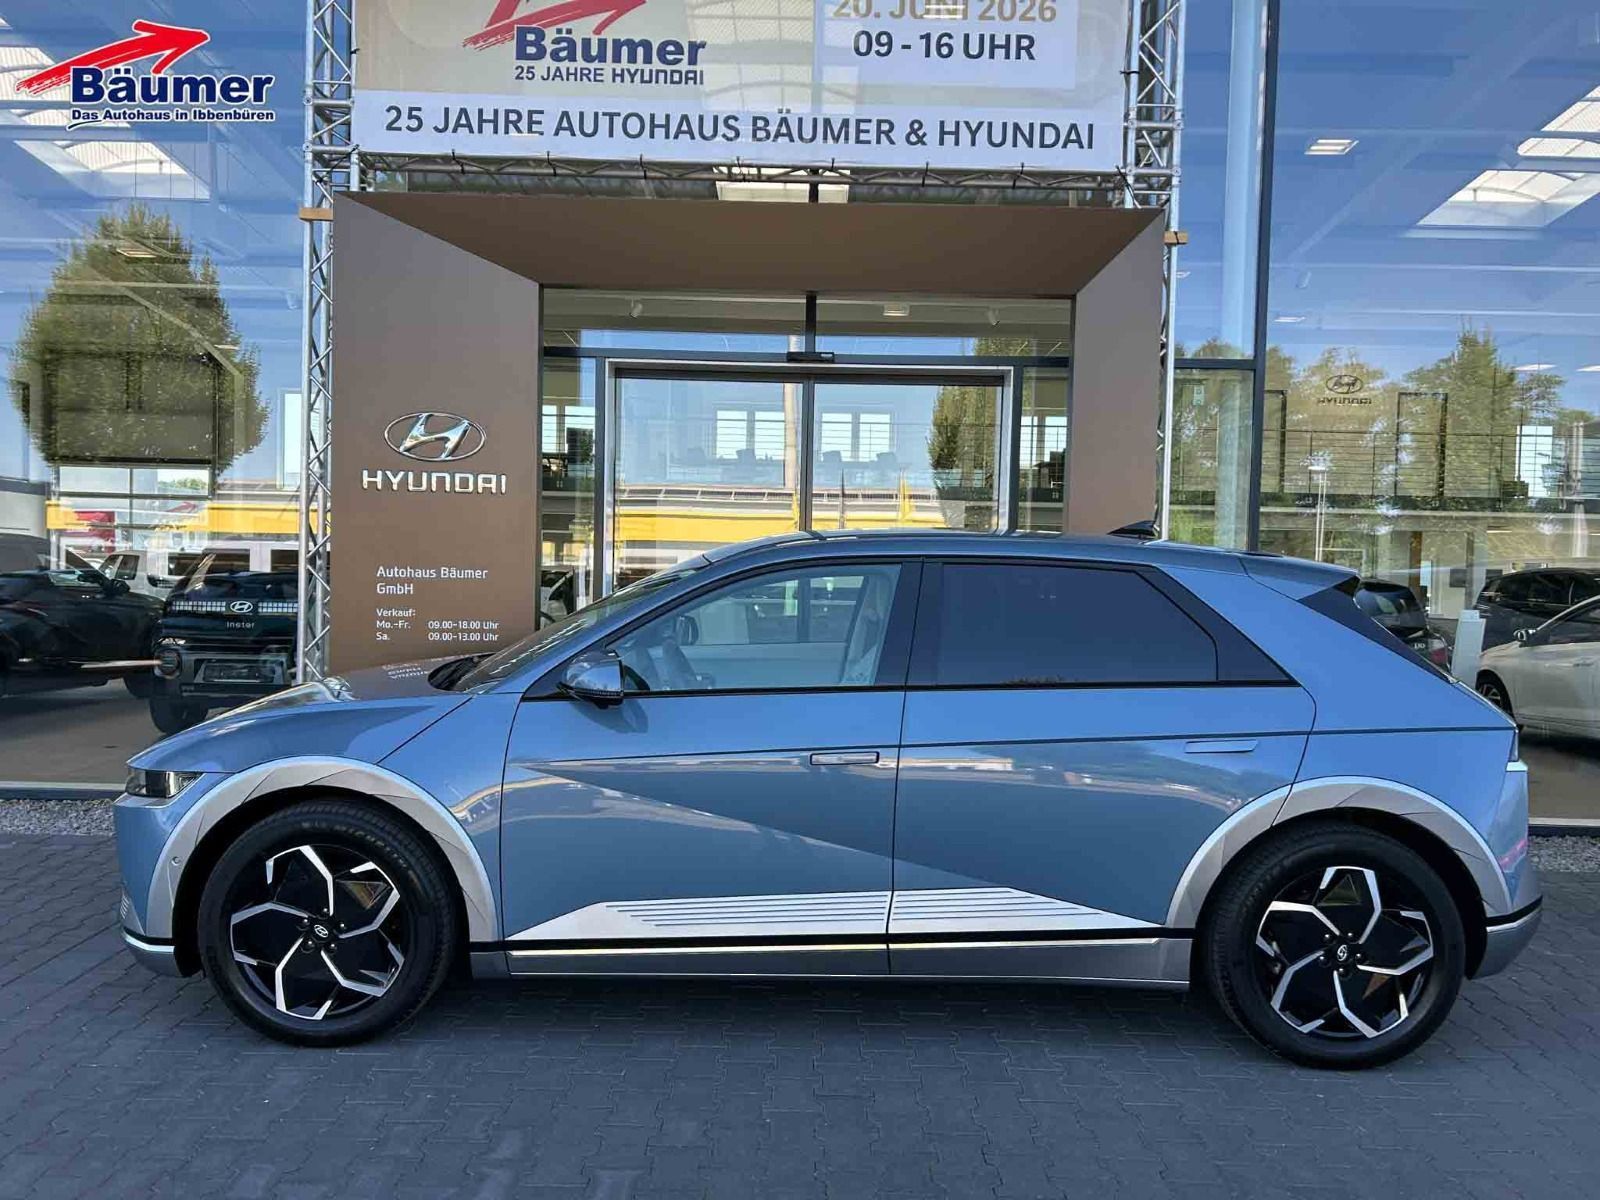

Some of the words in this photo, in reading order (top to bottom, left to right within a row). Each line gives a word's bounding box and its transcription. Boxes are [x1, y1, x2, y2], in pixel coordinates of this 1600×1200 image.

[833, 0, 881, 19] 20.
[978, 0, 1057, 22] 2026
[515, 26, 707, 66] Bäumer
[853, 30, 893, 57] 09
[919, 32, 954, 58] 16
[963, 33, 1036, 60] UHR
[515, 66, 535, 80] 25
[540, 67, 604, 82] JAHRE
[611, 69, 704, 85] HYUNDAI
[385, 105, 424, 132] 25
[432, 107, 545, 135] JAHRE
[553, 110, 740, 141] AUTOHAUS
[751, 108, 896, 145] BÄUMER
[905, 119, 928, 146] &
[938, 120, 1094, 149] HYUNDAI
[362, 469, 507, 494] HYUNDAI
[376, 566, 437, 578] Autohaus
[440, 567, 488, 579] Bäumer
[376, 583, 414, 595] GmbH
[376, 608, 416, 617] Verkauf:
[376, 620, 411, 629] Mo.-Fr.
[427, 620, 480, 630] 09.00-18.00
[482, 621, 499, 630] Uhr
[376, 632, 390, 641] Sa.
[427, 632, 480, 641] 09.00-13.00
[482, 632, 499, 641] Uhr
